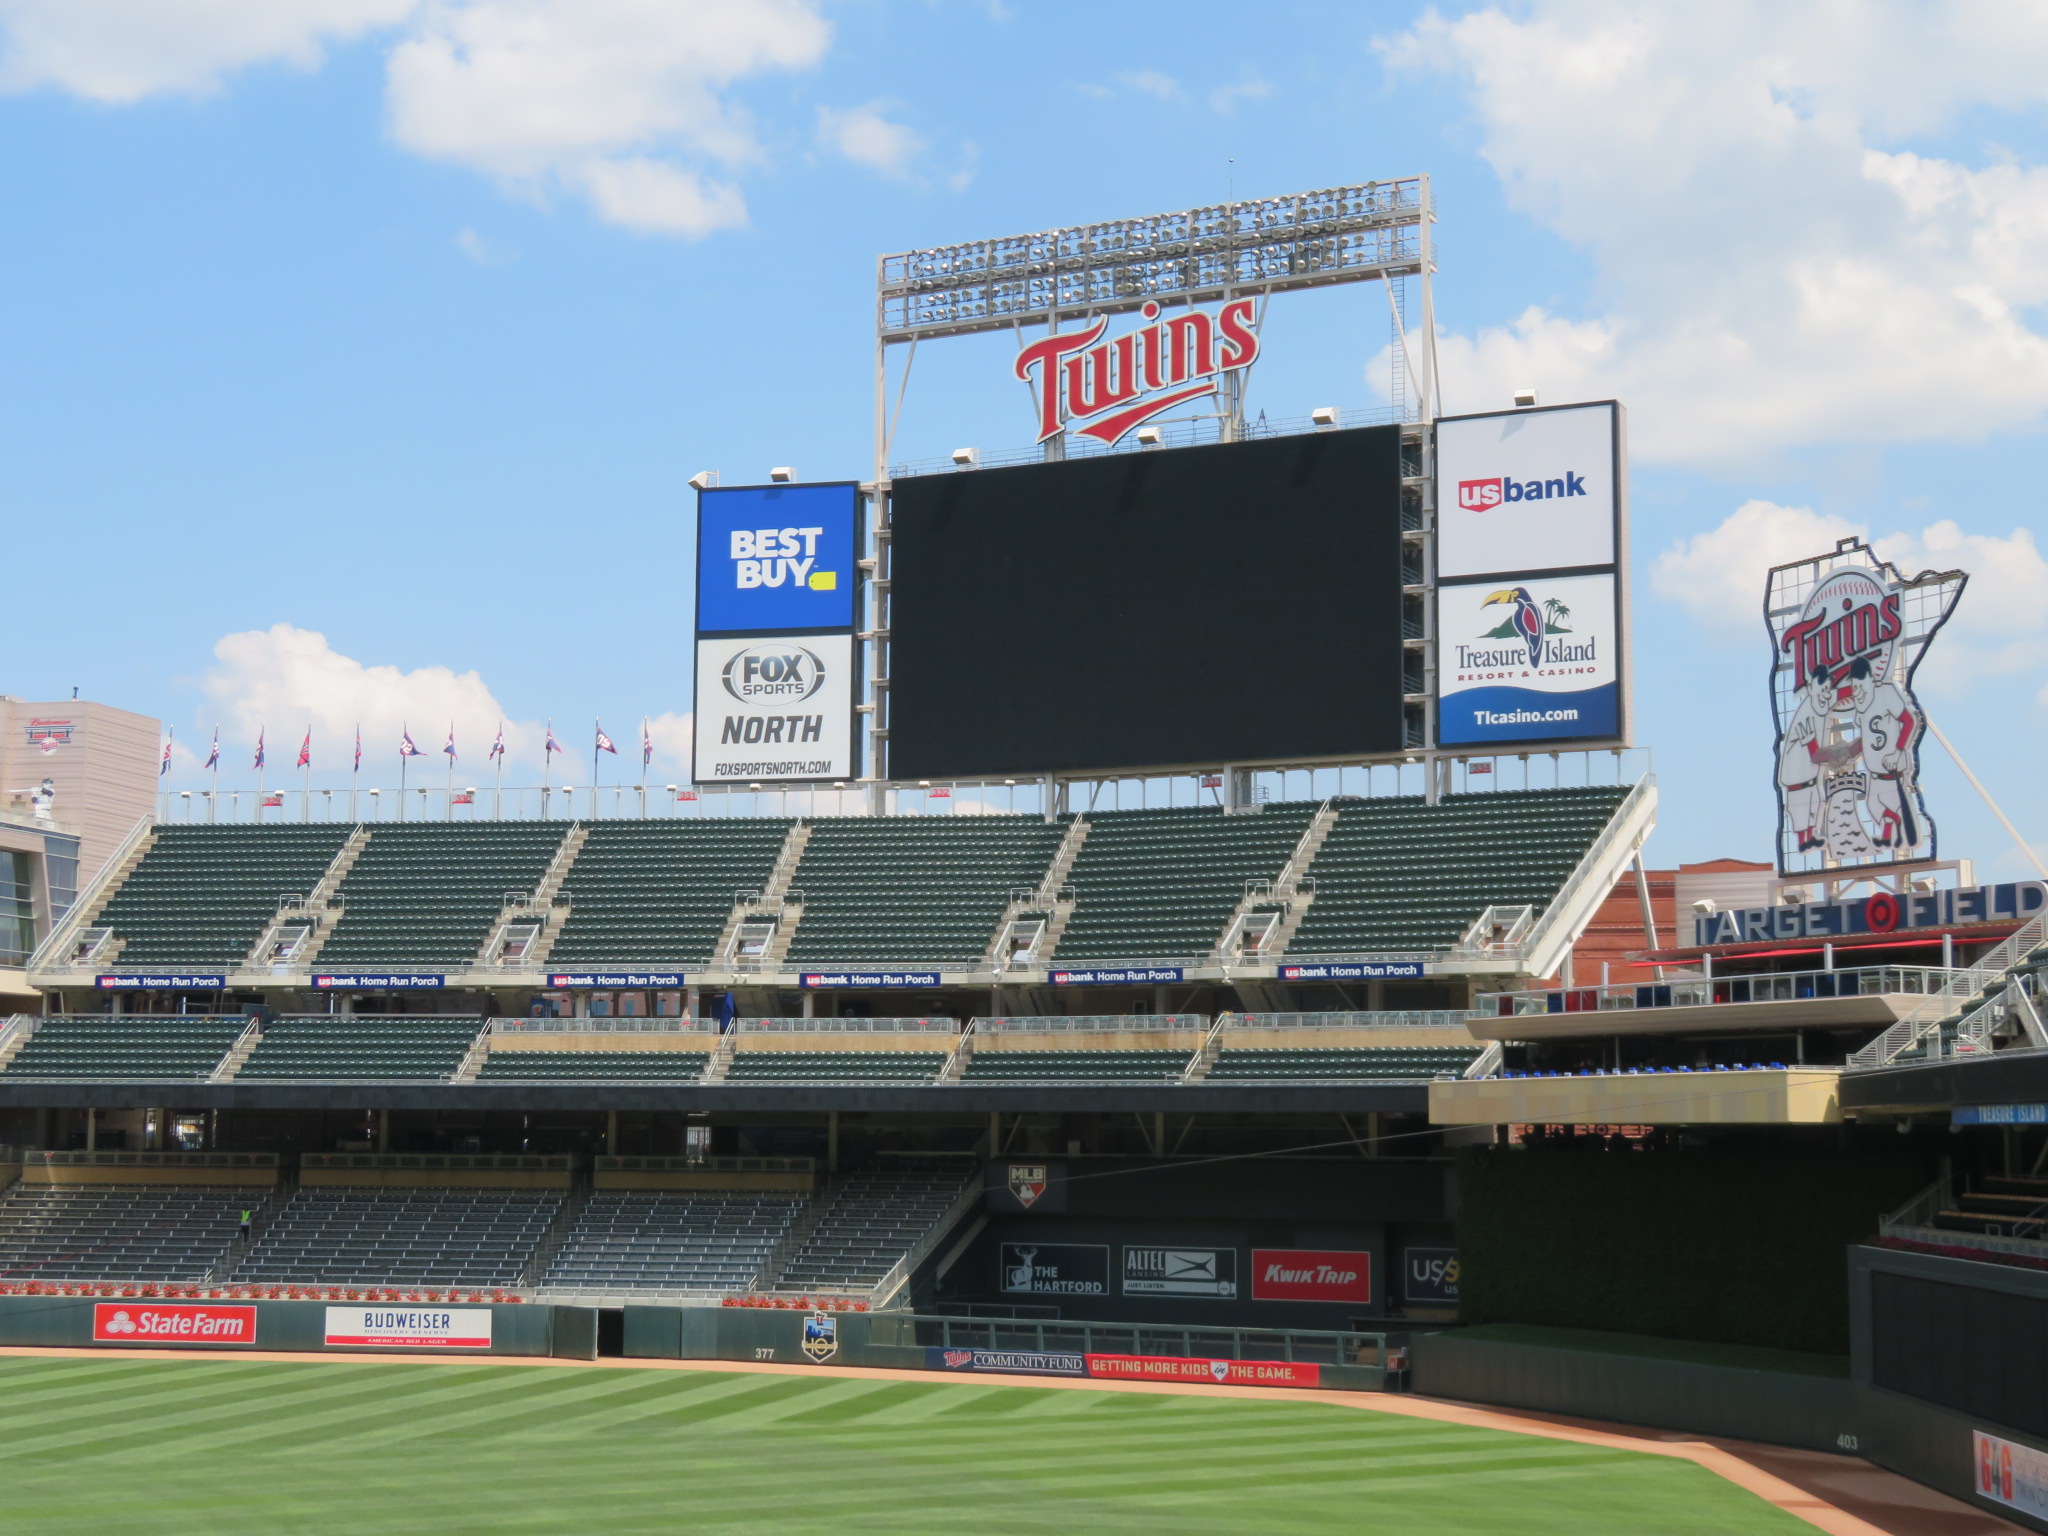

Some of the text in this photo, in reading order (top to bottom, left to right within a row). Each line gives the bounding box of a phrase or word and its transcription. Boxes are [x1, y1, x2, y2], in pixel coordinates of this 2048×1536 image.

[1013, 297, 1260, 445] Twins
[730, 527, 823, 559] BEST
[736, 557, 814, 589] BUY
[1781, 592, 1901, 693] Twins
[1455, 636, 1597, 669] Treasure Island
[743, 655, 803, 683] FOX
[1458, 672, 1514, 681] RESORT
[1538, 667, 1597, 677] CASINO
[742, 683, 804, 695] SPORTS
[721, 714, 823, 744] NORTH
[714, 760, 832, 776] FOXSPORTSNORTH.COM
[1692, 880, 2048, 945] TARGET FIELD
[1097, 971, 1125, 981] Home
[1127, 971, 1146, 980] Run
[1149, 970, 1176, 980] Porch
[1331, 967, 1361, 976] Home
[1364, 966, 1384, 975] Run
[1386, 965, 1417, 975] Porch
[143, 977, 170, 986] Home
[172, 977, 190, 986] Run
[192, 977, 220, 986] Porch
[360, 977, 388, 986] Home
[390, 977, 408, 986] Run
[410, 977, 438, 986] Porch
[597, 976, 625, 985] Home
[628, 976, 647, 985] Run
[649, 976, 677, 985] Porch
[851, 975, 880, 984] Home
[883, 975, 902, 984] Run
[905, 975, 934, 984] Porch
[1979, 1104, 2046, 1122] TREASURE ISLAND
[1011, 1168, 1044, 1179] MLB
[1127, 1250, 1165, 1271] ALTEC
[1034, 1267, 1057, 1278] THE
[1126, 1270, 1165, 1278] LANSING
[1034, 1280, 1102, 1293] HARTFORD
[364, 1313, 450, 1328] BUDWEISER
[755, 1348, 774, 1359] 377
[944, 1350, 1082, 1370] Twins COMMUNITY FUND
[1092, 1359, 1295, 1380] GETTING MORE KIDS in THE GAME.
[1837, 1434, 1858, 1450] 403
